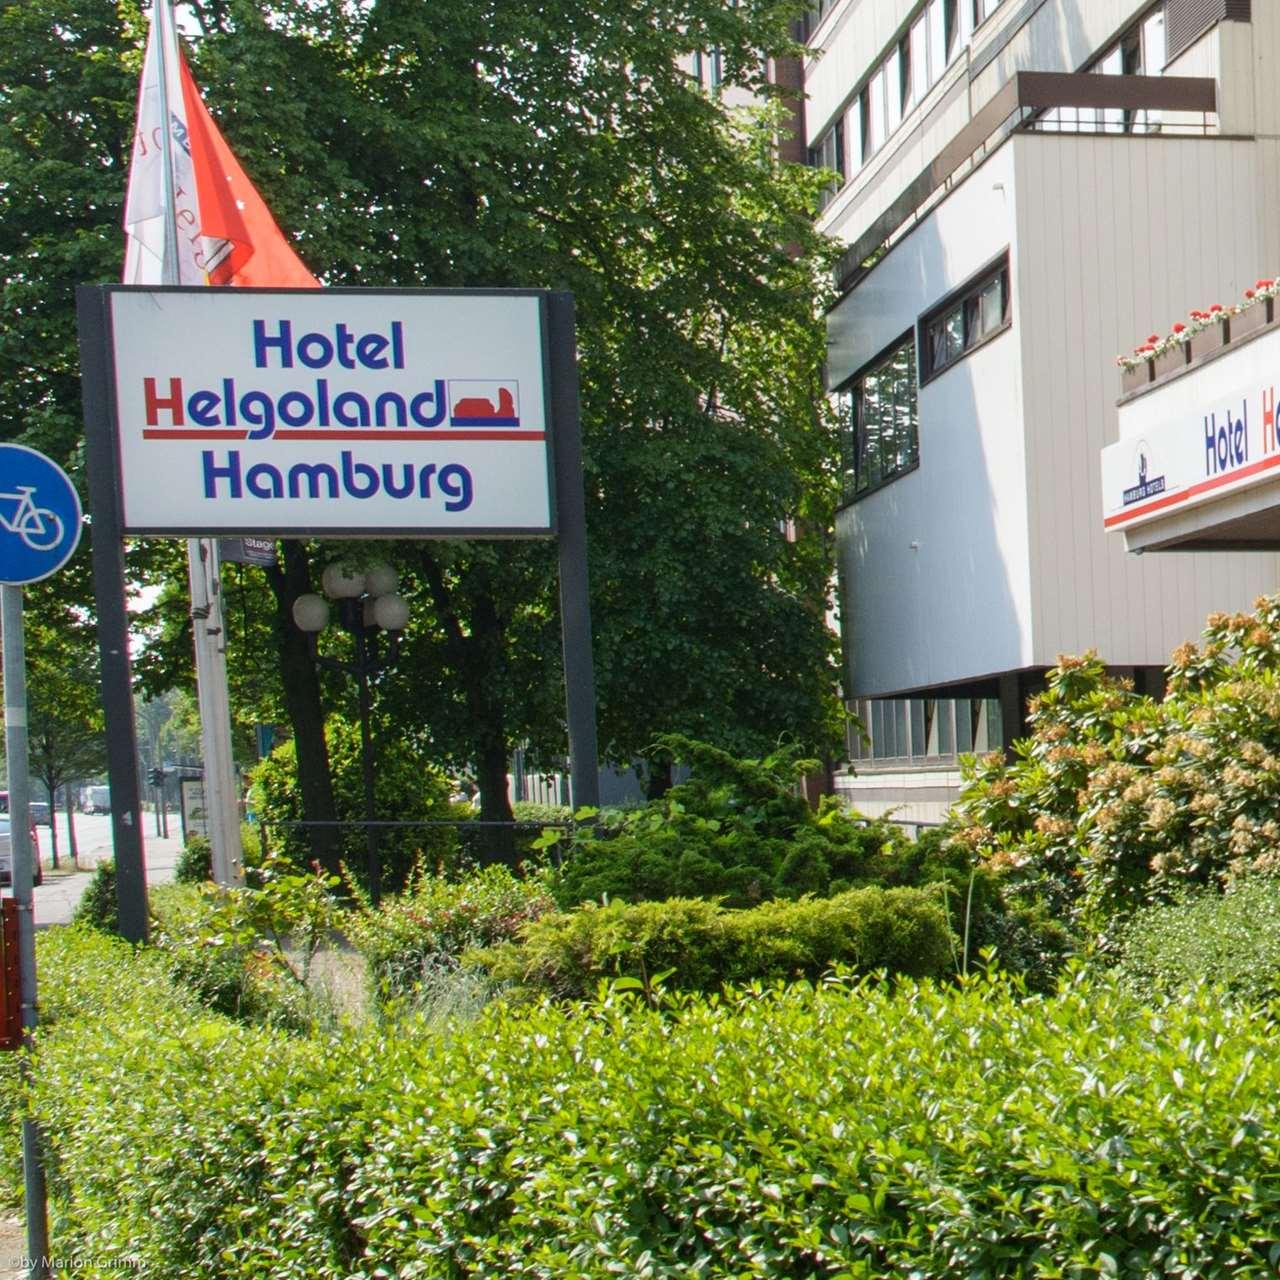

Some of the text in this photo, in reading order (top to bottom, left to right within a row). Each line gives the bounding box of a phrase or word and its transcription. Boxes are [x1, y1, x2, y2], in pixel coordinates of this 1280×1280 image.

[253, 319, 405, 370] Hotel
[143, 377, 447, 440] Helgoland
[1204, 398, 1249, 476] Hotel
[201, 450, 474, 512] Hamburg
